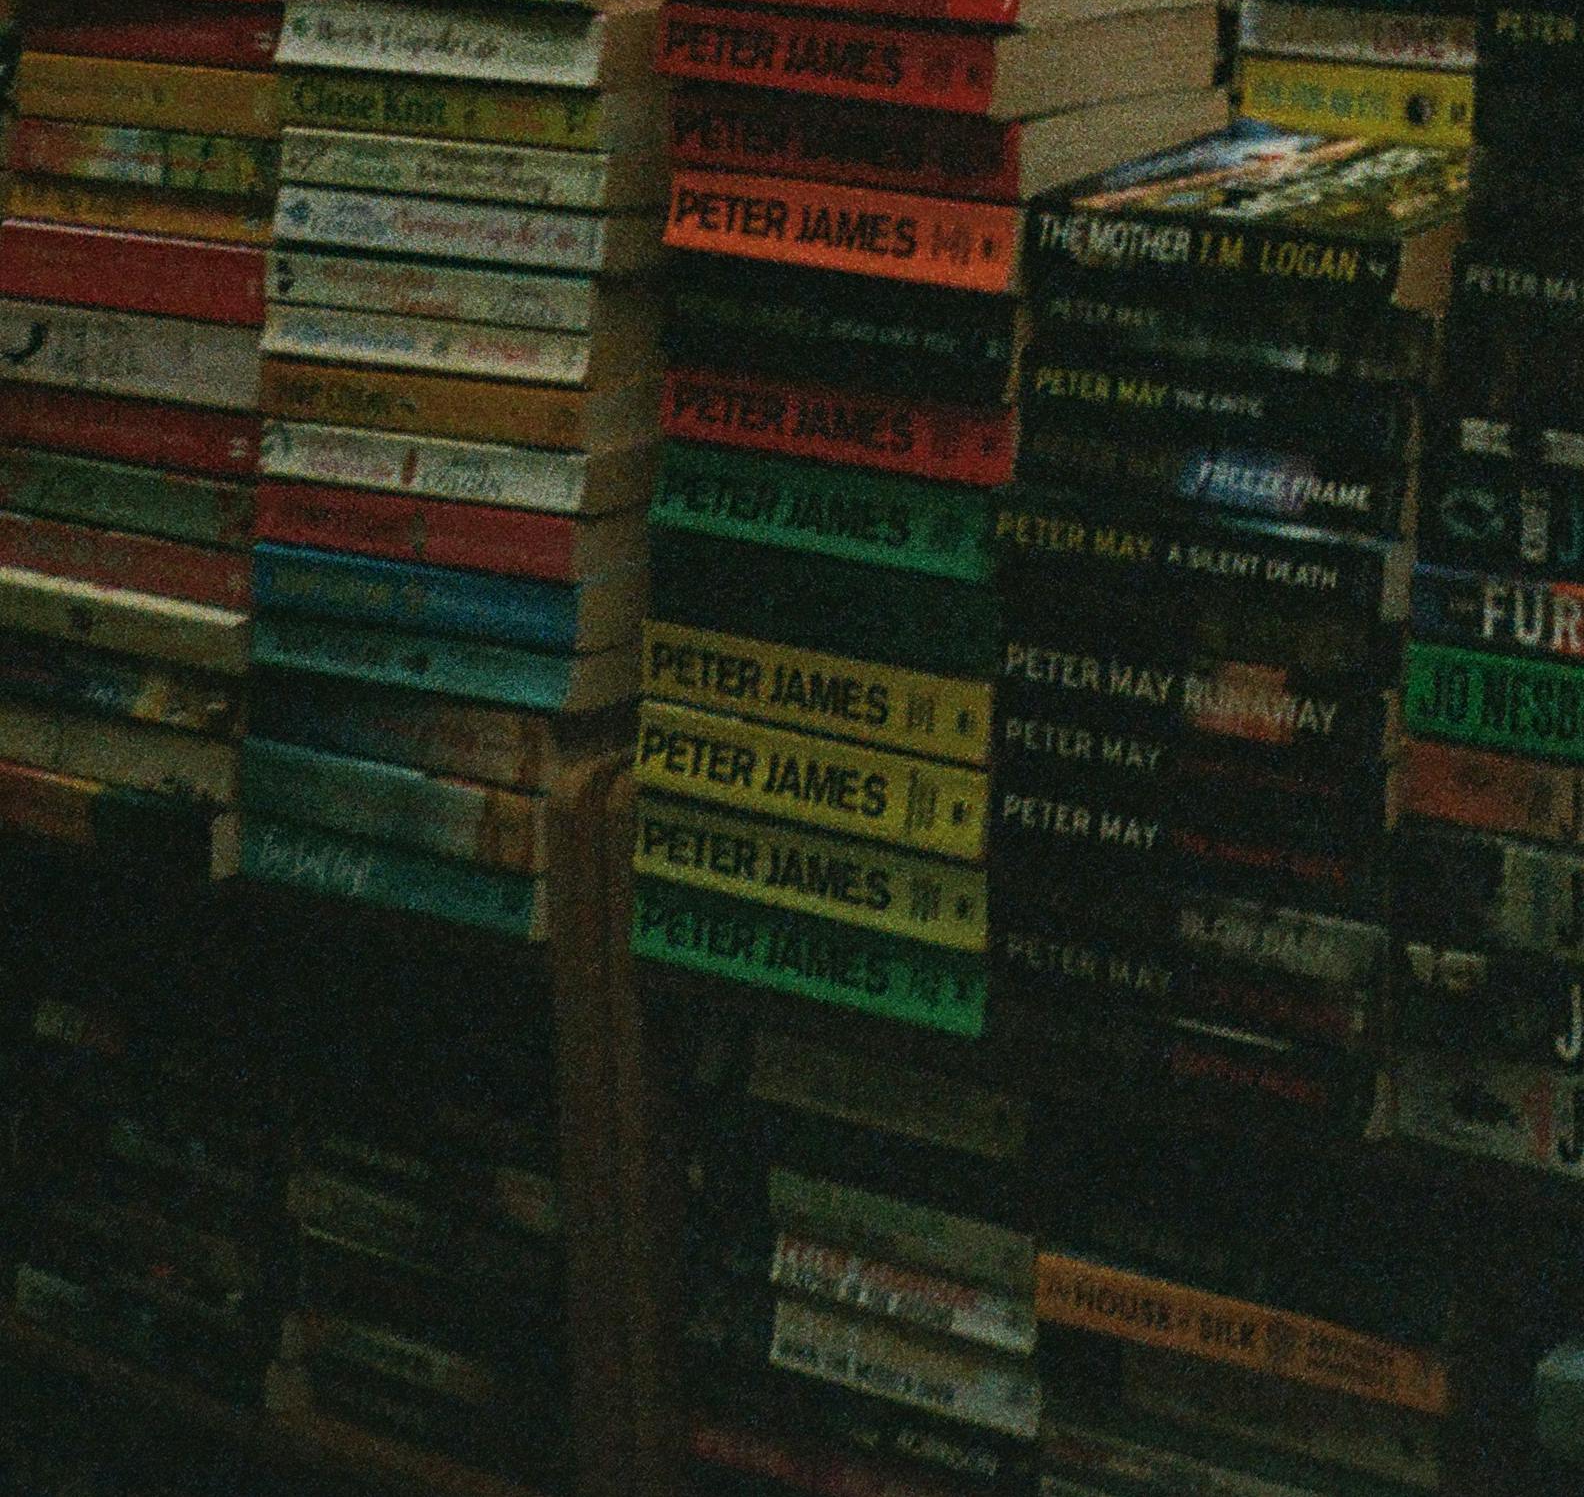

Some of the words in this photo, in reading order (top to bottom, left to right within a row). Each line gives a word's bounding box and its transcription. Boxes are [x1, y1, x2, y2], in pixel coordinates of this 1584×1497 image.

[668, 21, 777, 71] PETER
[783, 34, 903, 85] JAMES
[1495, 10, 1576, 44] PETER
[292, 79, 376, 121] Close
[675, 187, 789, 241] PETER
[795, 203, 918, 259] JAMES
[1038, 215, 1087, 255] THE
[1089, 219, 1192, 264] MOTHER
[1259, 238, 1359, 283] LOGAN
[672, 381, 786, 433] PETER
[795, 396, 914, 454] JAMES
[1035, 369, 1112, 401] PETER
[1116, 376, 1170, 408] MAY
[662, 468, 783, 522] PETER
[792, 491, 910, 547] JAMES
[1292, 470, 1372, 512] FRAME
[995, 511, 1086, 549] PETER
[1093, 527, 1154, 562] MAY
[1263, 554, 1339, 590] DEATH
[650, 639, 762, 698] PETER
[769, 662, 890, 726] JAMES
[1004, 640, 1101, 690] PETER
[1109, 663, 1175, 705] MAY
[1183, 673, 1339, 735] RUNAWAY
[1415, 664, 1469, 723] JO
[638, 727, 755, 790] PETER
[761, 751, 889, 819] JAMES
[1004, 717, 1093, 758] PETER
[1099, 733, 1162, 772] MAY
[1002, 793, 1091, 837] PETER
[1099, 812, 1160, 852] MAY
[642, 818, 757, 876] PETER
[768, 846, 892, 911] JAMES
[639, 901, 757, 952] PETER
[769, 919, 891, 995] JAMES
[1005, 932, 1097, 980] PETER
[1107, 955, 1175, 994] MAY
[1075, 1277, 1170, 1332] HOUSE
[1197, 1311, 1256, 1350] SILK
